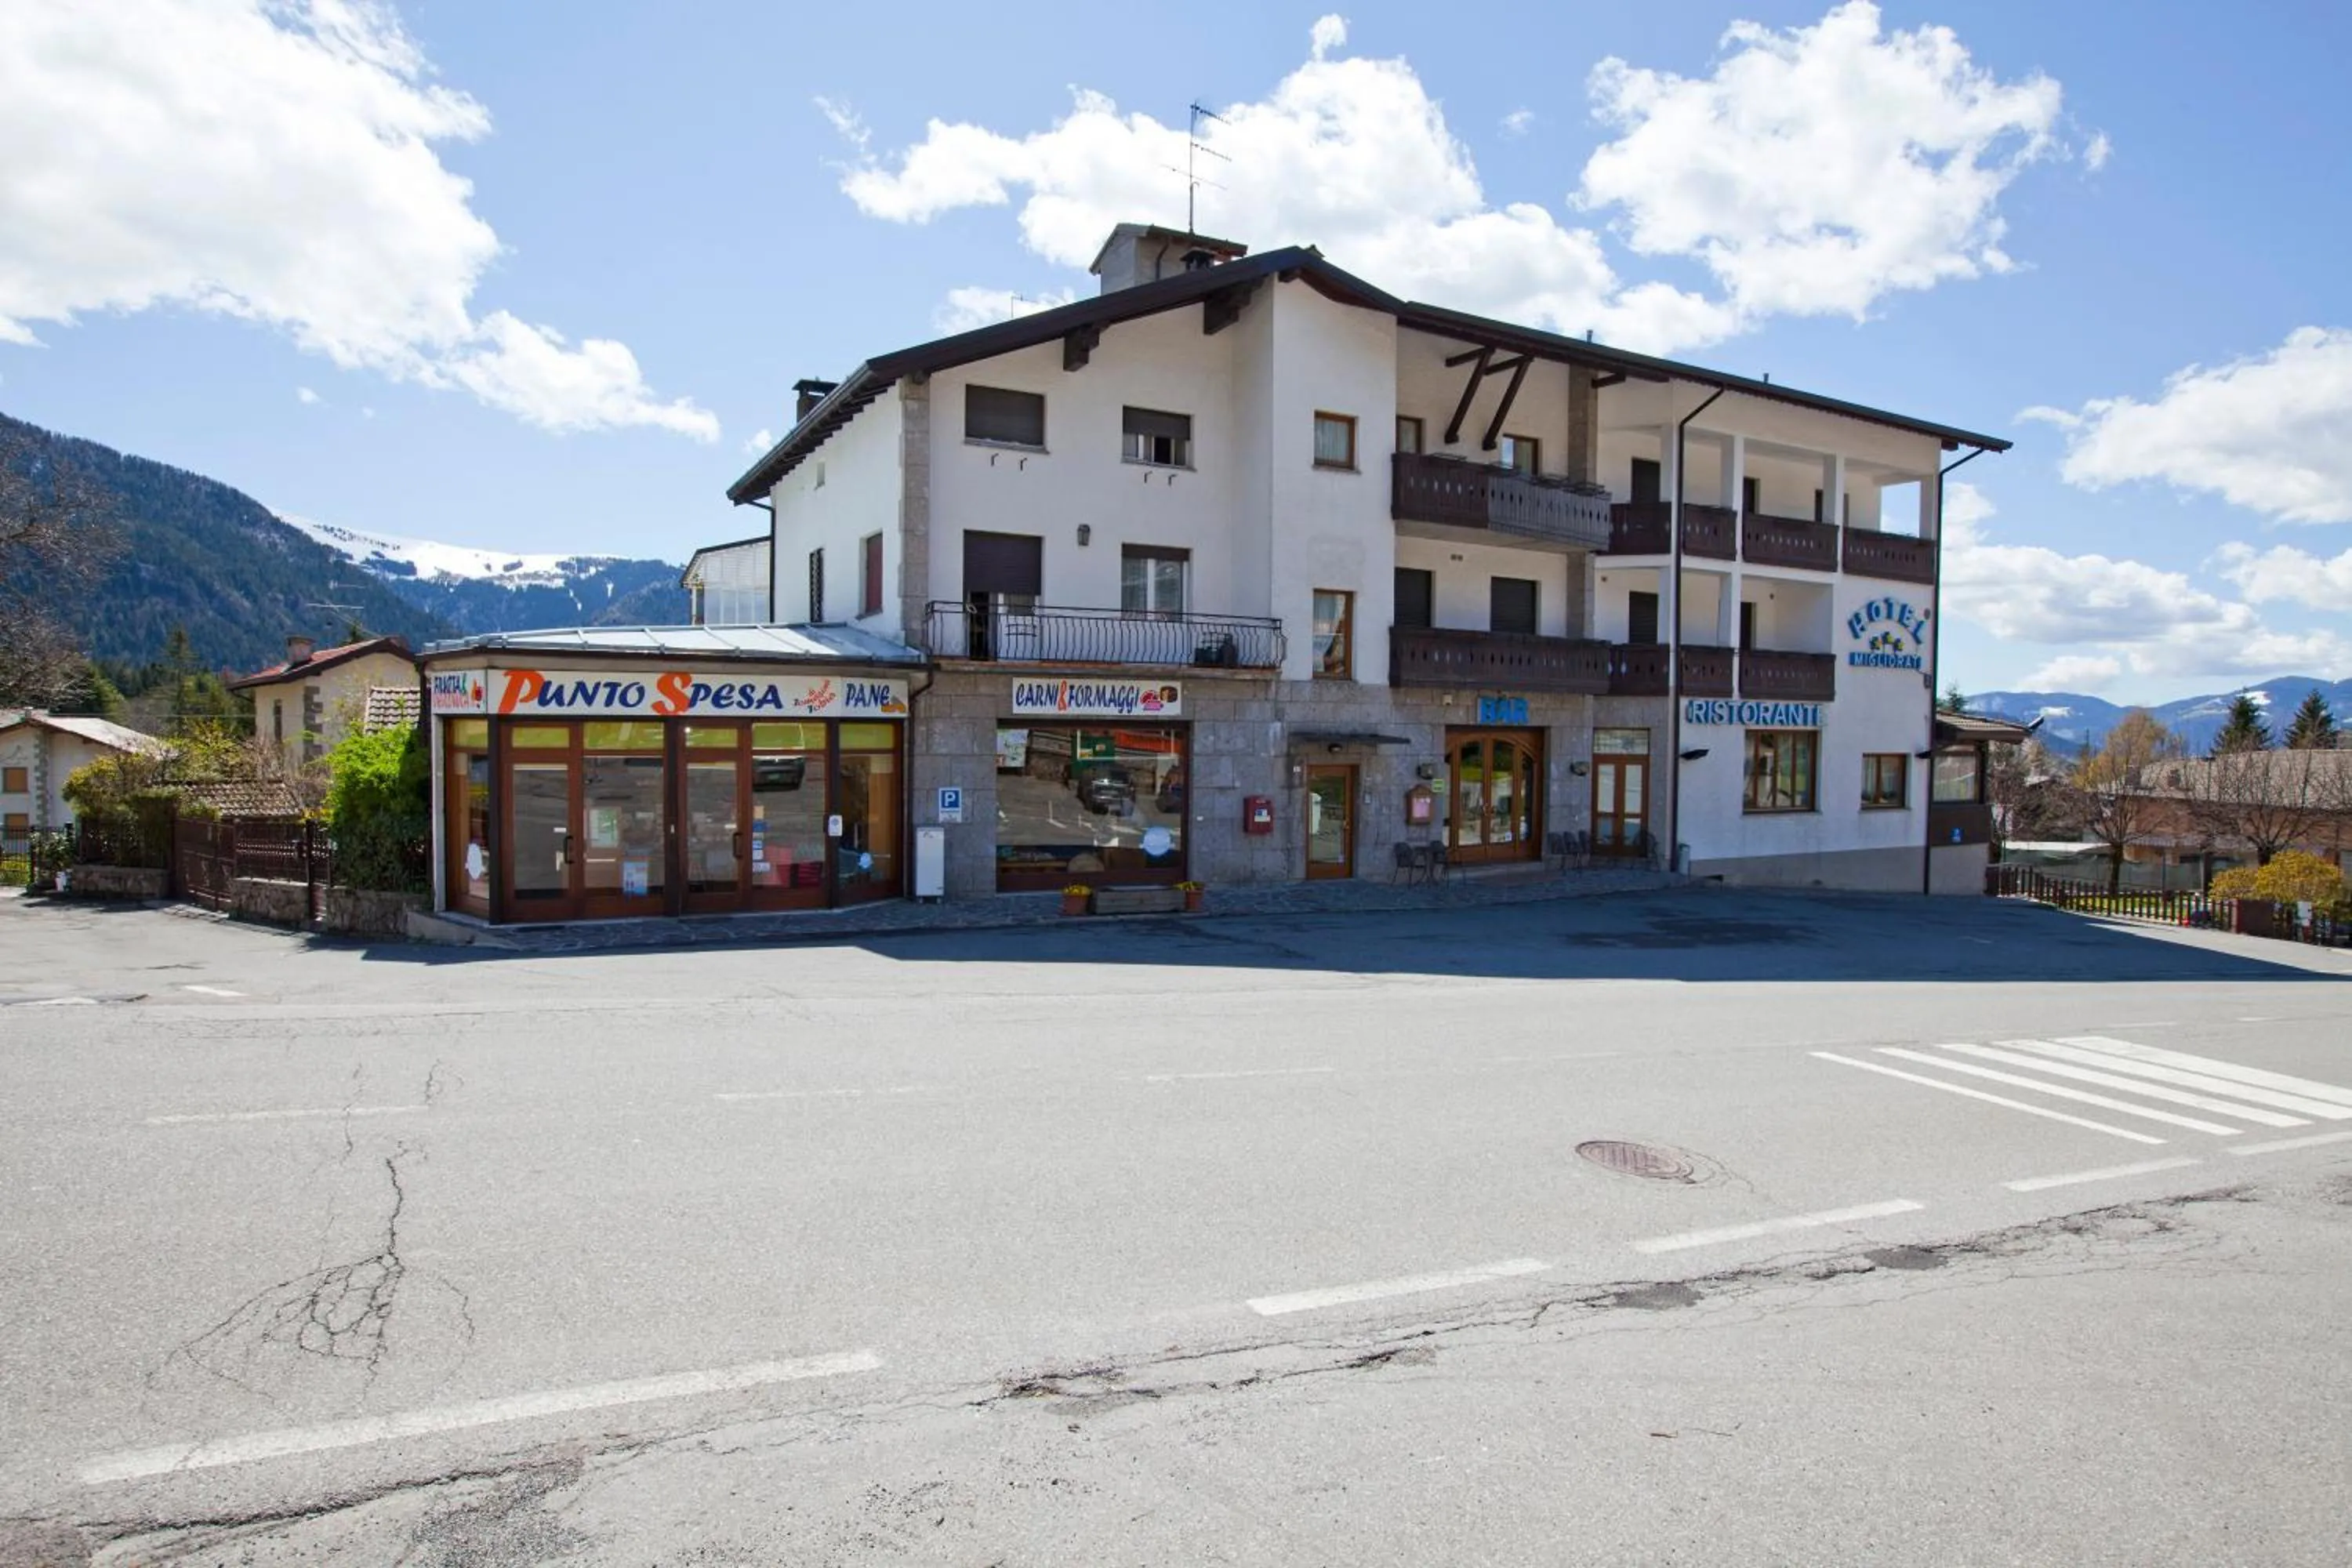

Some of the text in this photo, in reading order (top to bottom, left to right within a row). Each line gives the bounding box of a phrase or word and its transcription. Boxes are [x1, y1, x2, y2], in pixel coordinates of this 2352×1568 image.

[1848, 597, 1926, 645] HOTEL
[845, 683, 891, 708] PANE
[1015, 683, 1058, 706] CARNI
[1068, 684, 1139, 713] FORMAGGI
[1477, 696, 1530, 725] BAR
[1686, 699, 1829, 726] RISTORANTE
[945, 792, 956, 806] P
